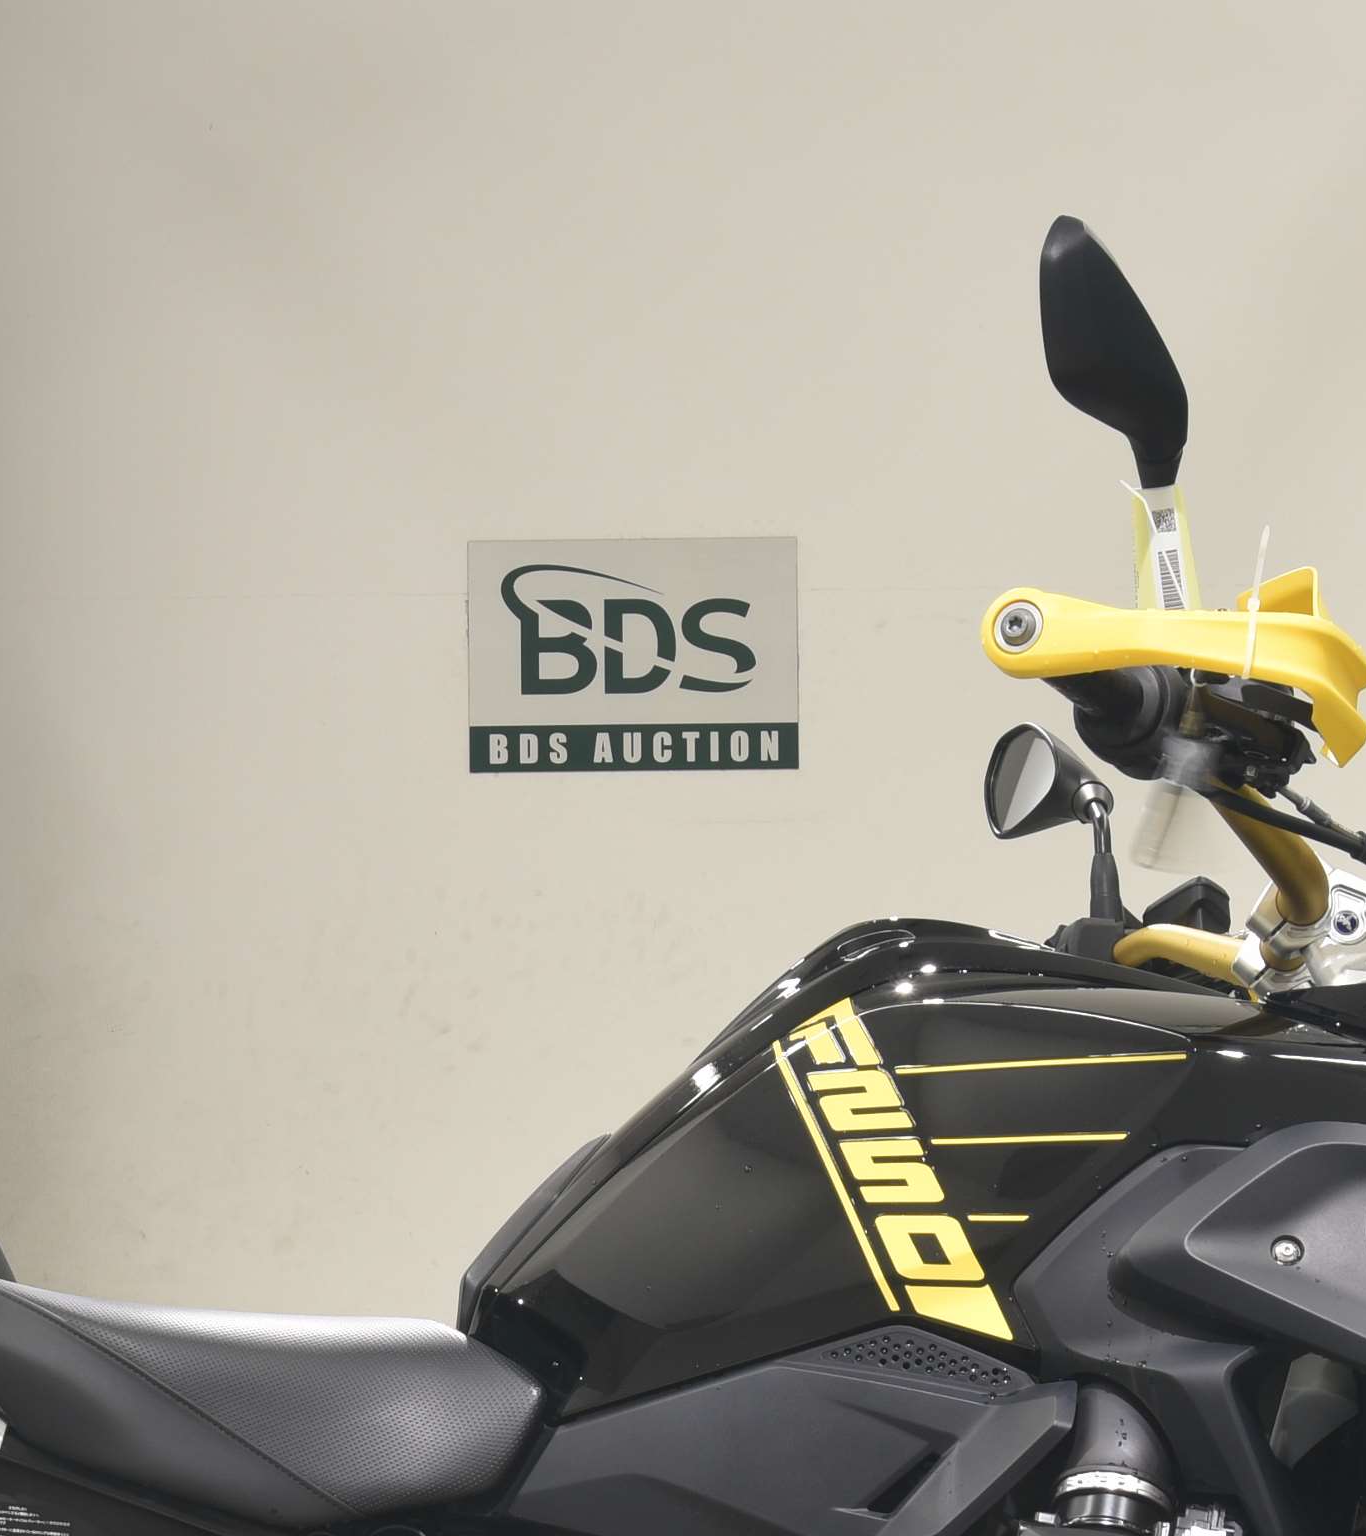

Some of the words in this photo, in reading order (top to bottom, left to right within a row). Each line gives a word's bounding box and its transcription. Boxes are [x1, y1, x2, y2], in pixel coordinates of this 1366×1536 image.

[501, 563, 757, 696] BDS
[488, 732, 569, 765] BDS
[592, 730, 781, 764] AUCTION
